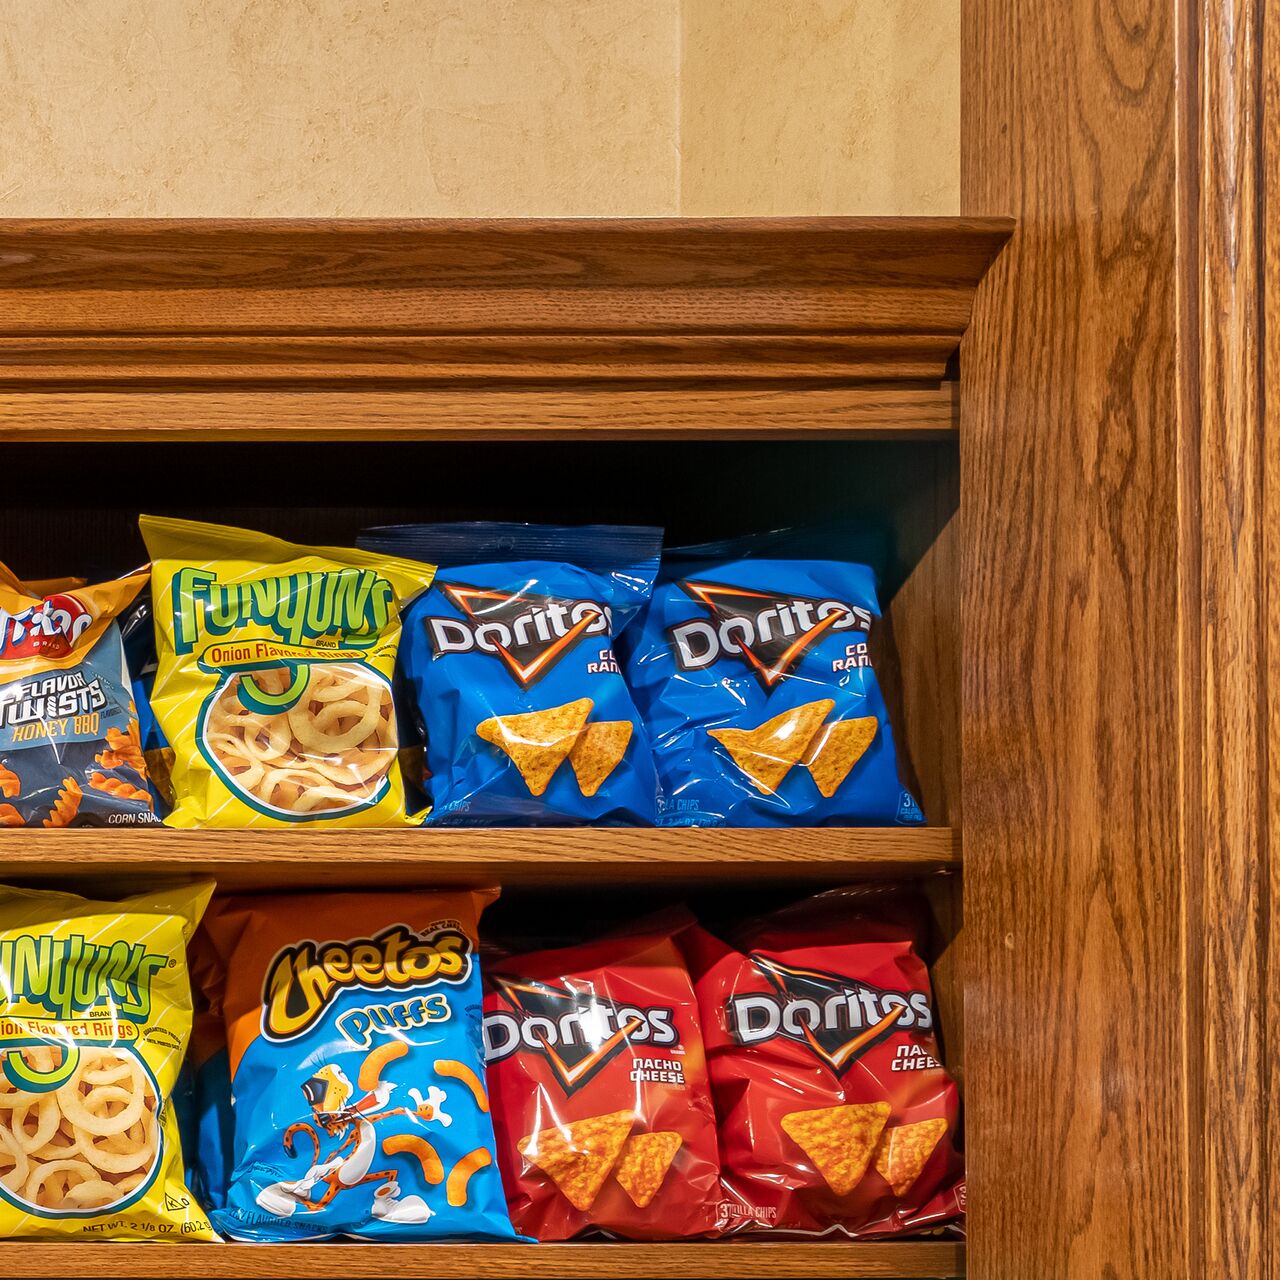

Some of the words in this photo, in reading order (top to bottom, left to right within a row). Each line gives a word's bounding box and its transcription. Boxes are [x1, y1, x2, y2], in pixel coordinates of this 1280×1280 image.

[316, 640, 336, 648] BRAND
[212, 647, 253, 663] Onion
[21, 672, 86, 696] FLAVOR
[12, 719, 72, 742] HONEY
[74, 713, 100, 735] BBQ
[109, 814, 136, 823] CORN
[263, 925, 471, 1039] Cheetos
[733, 990, 932, 1045] Doritos
[92, 1022, 133, 1038] Rings
[483, 1005, 680, 1063] Doritos
[633, 1059, 682, 1071] NACHO
[630, 1070, 685, 1084] CHEESE
[130, 1221, 137, 1229] 2
[140, 1222, 156, 1233] 1/8
